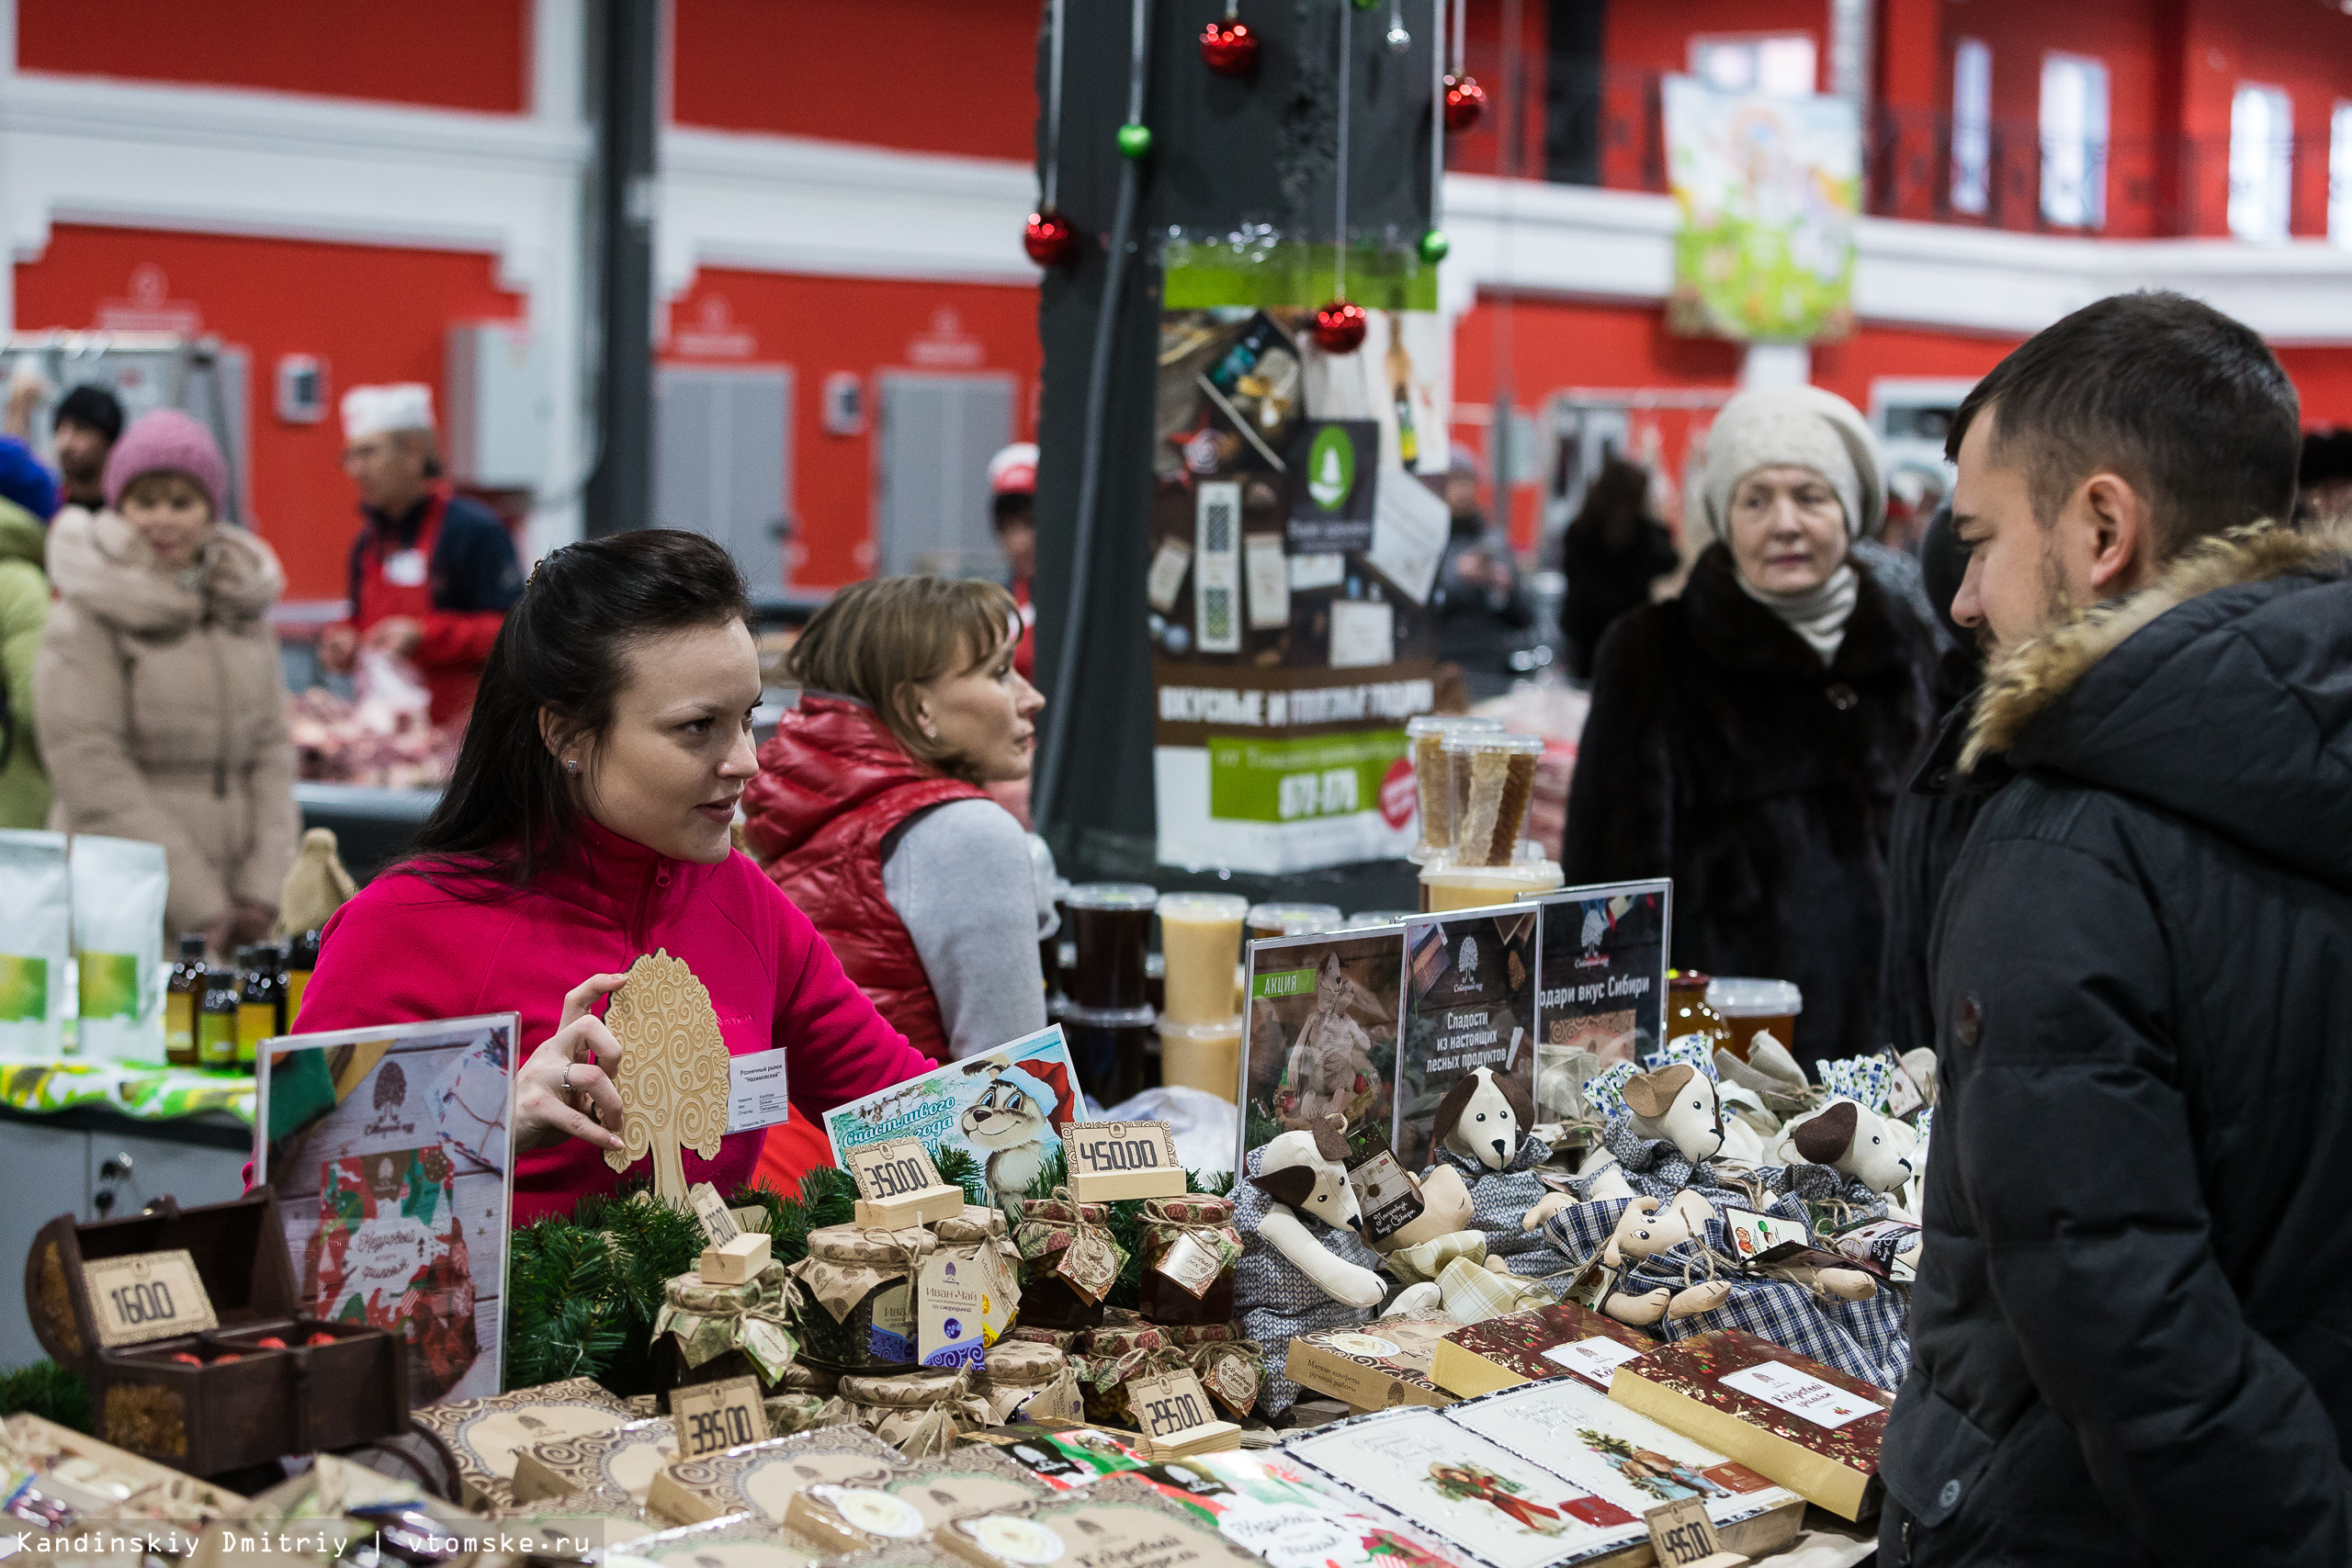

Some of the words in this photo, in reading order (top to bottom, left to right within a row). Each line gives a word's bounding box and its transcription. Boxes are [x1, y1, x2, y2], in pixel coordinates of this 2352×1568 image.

[1264, 976, 1296, 995] АКЦИЯ
[1540, 987, 1576, 1010] одари
[1578, 982, 1605, 1005] вкус
[1608, 974, 1650, 998] Сибири
[1447, 1011, 1488, 1031] Сладости
[1437, 1037, 1447, 1051] из
[1450, 1030, 1498, 1048] настоящих
[740, 1066, 767, 1077] Розничный
[767, 1064, 783, 1072] рынок
[1426, 1055, 1460, 1073] лесных
[1462, 1047, 1507, 1070] продуктов
[842, 1097, 956, 1148] Счастливого
[913, 1116, 954, 1141] года
[1374, 1201, 1408, 1226] Попробуй
[1376, 1224, 1392, 1235] вкус
[1390, 1209, 1416, 1226] Сибири
[111, 1281, 176, 1324] 1600
[1222, 1361, 1253, 1389] Кедровый
[1307, 1359, 1331, 1375] Мягкие
[1332, 1369, 1361, 1386] конфеты
[1309, 1371, 1332, 1384] ручной
[1333, 1379, 1357, 1393] работы
[1770, 1382, 1826, 1404] Кедровый
